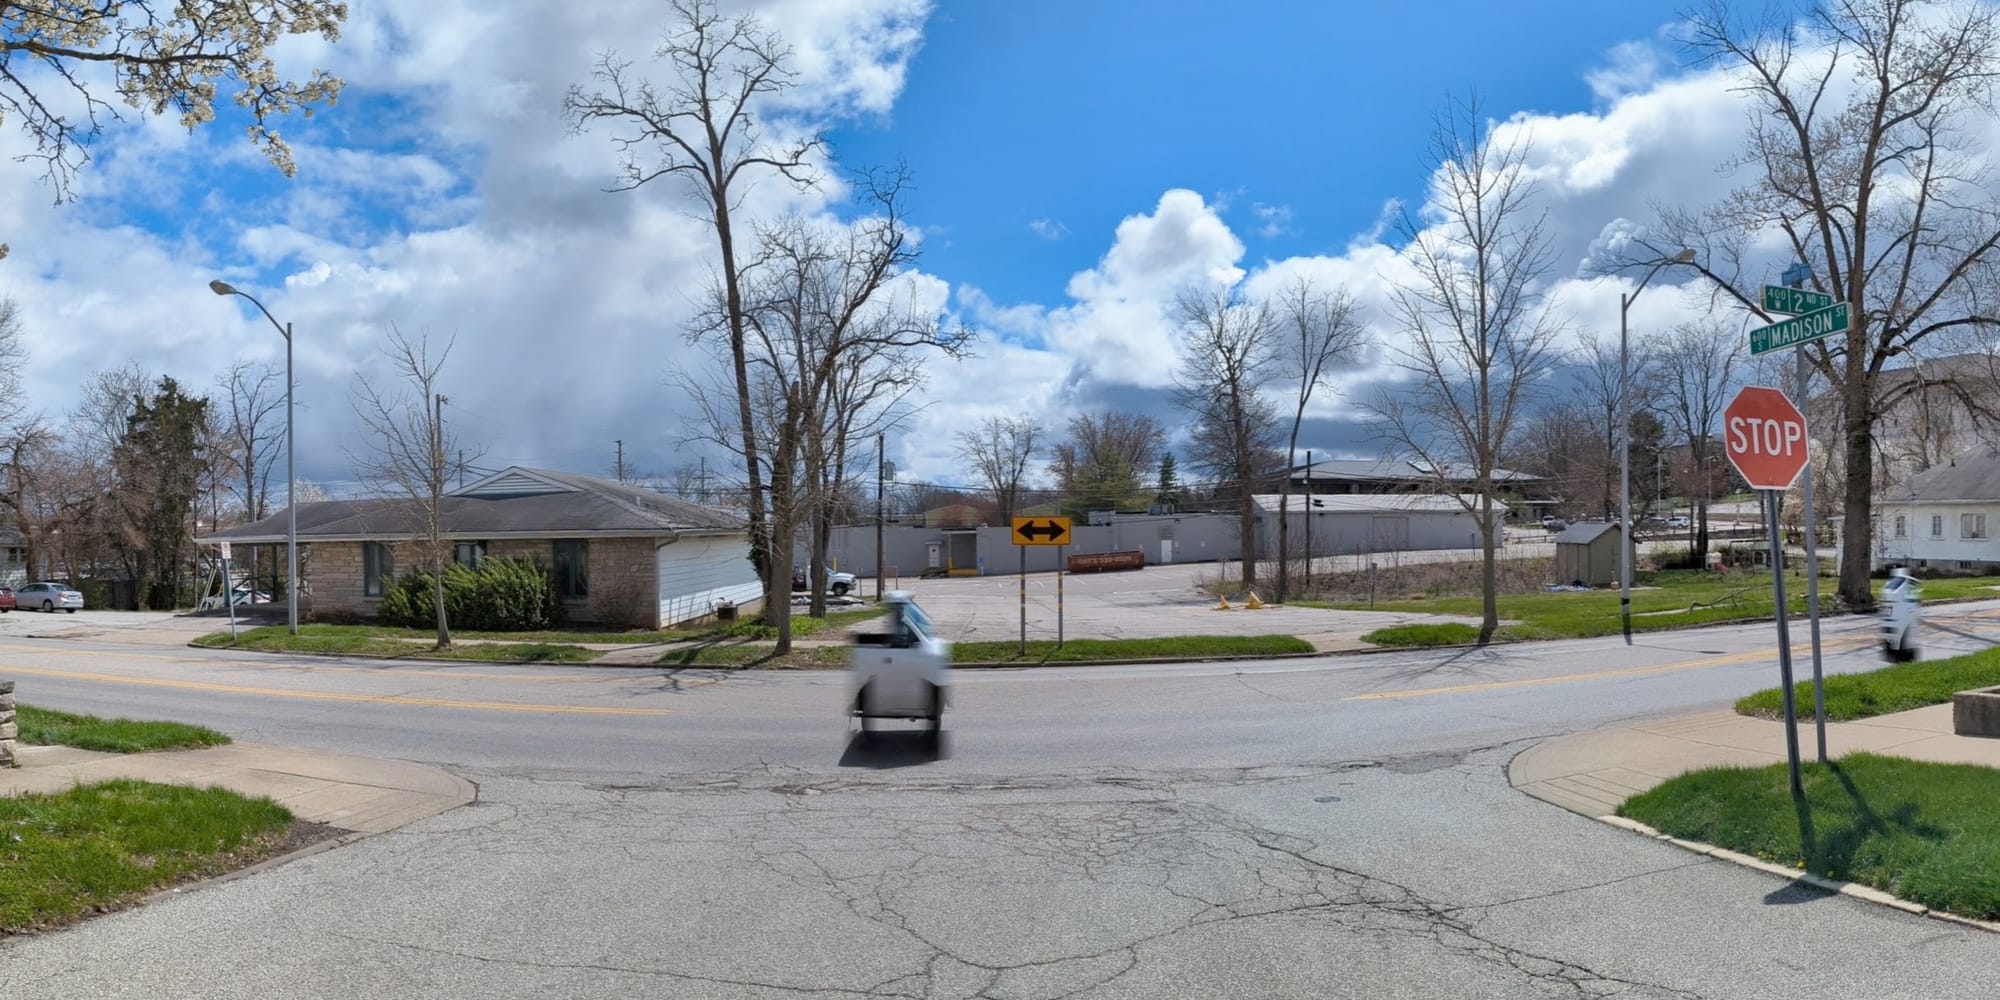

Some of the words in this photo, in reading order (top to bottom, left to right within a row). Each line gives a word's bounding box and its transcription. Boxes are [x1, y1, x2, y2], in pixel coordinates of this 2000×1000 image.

[1768, 288, 1787, 300] 400
[1794, 293, 1804, 312] 2
[1806, 293, 1817, 304] ND
[1820, 296, 1829, 306] ST
[1771, 311, 1832, 346] MADISON
[1836, 305, 1845, 317] ST
[1731, 417, 1801, 456] STOP
